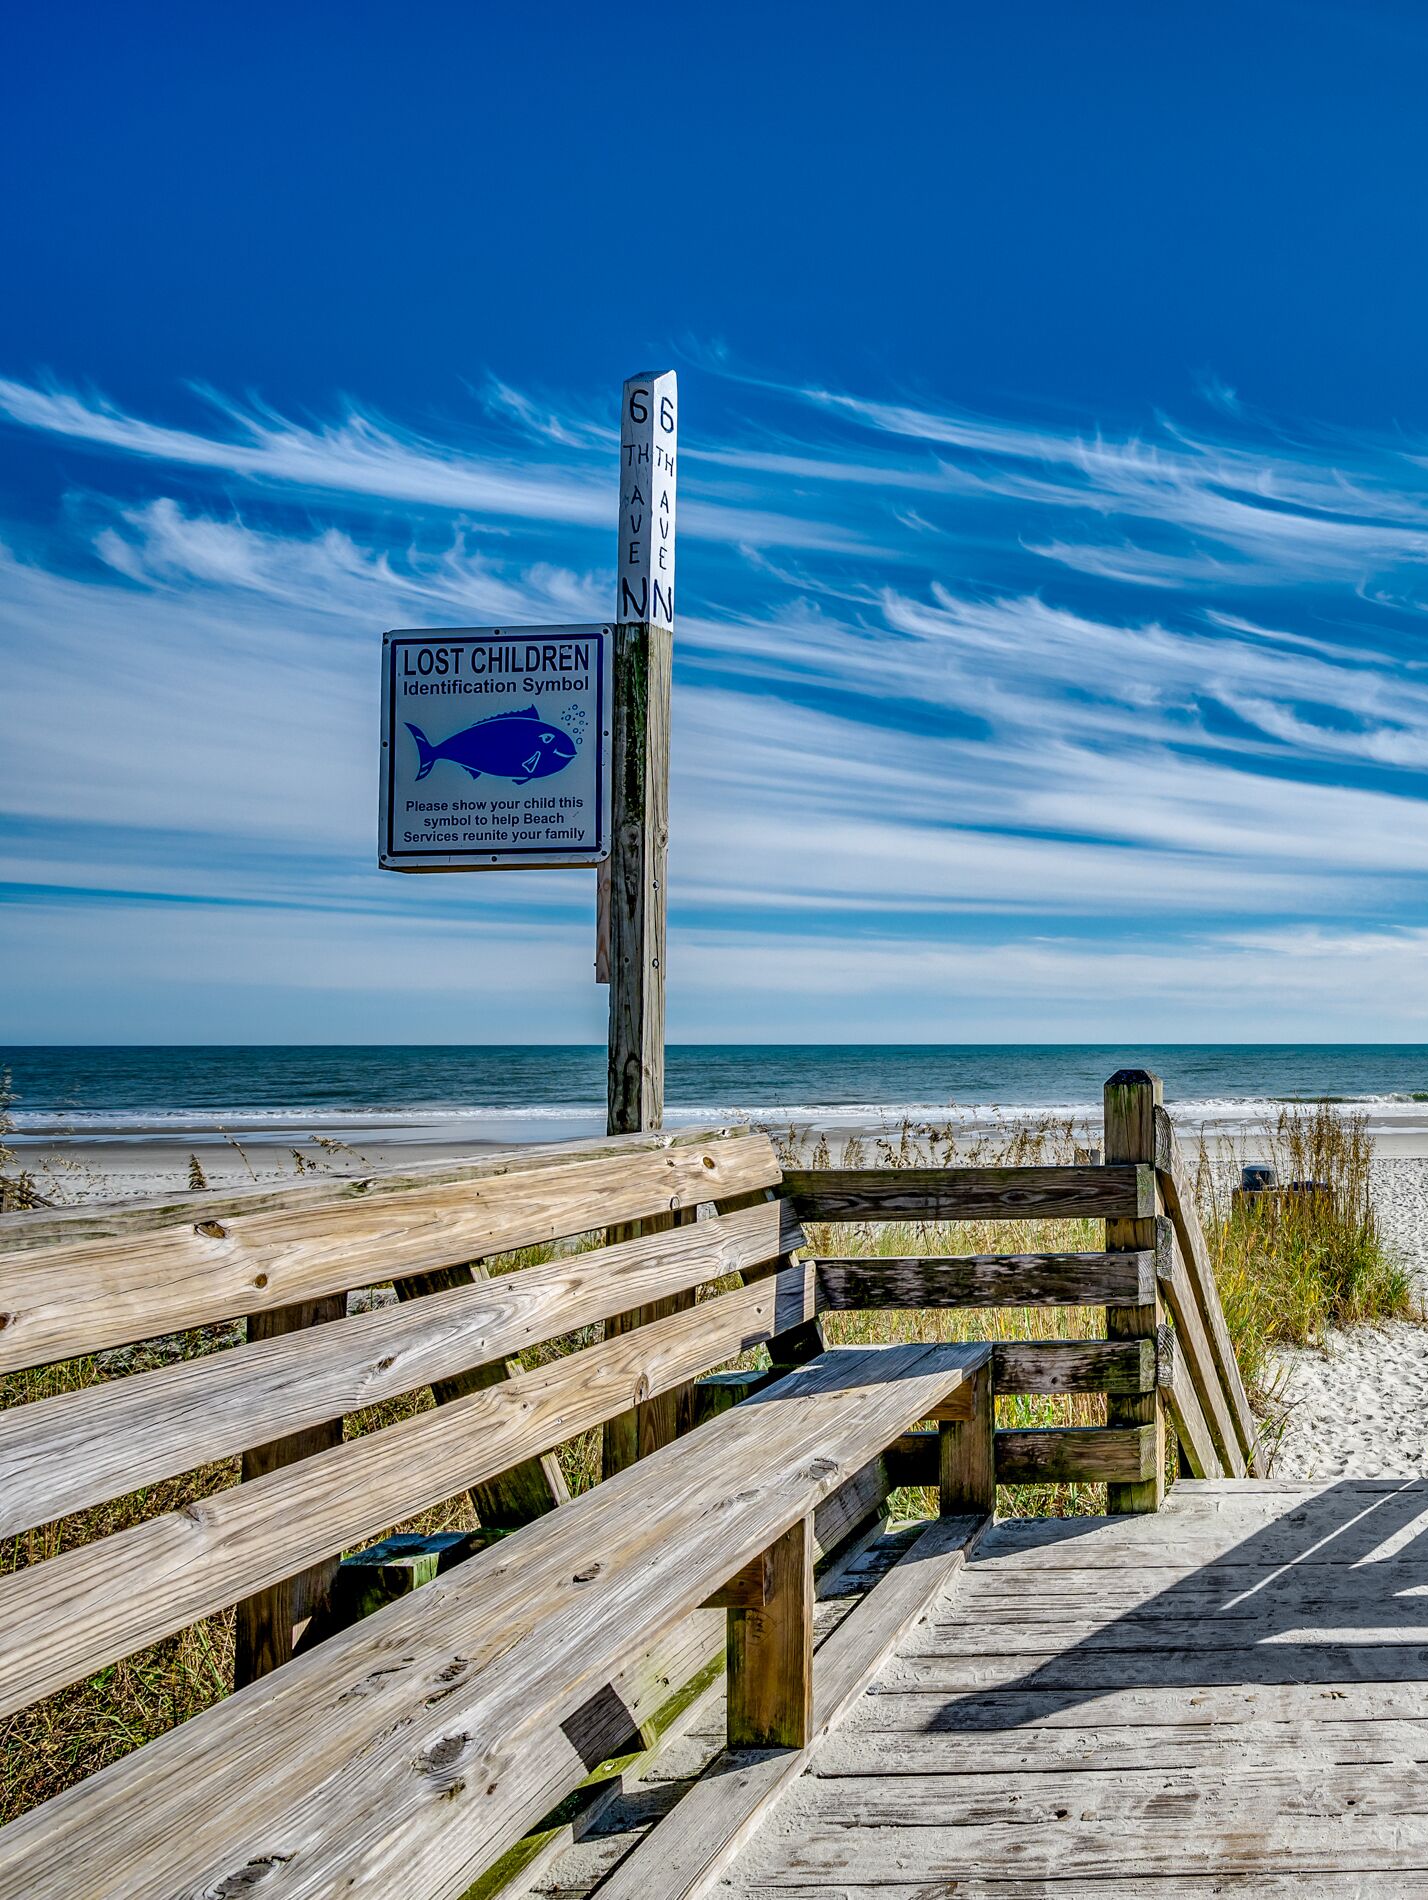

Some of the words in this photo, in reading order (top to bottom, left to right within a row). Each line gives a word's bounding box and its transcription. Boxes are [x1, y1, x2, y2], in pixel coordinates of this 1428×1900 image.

[630, 389, 649, 423] 6
[660, 397, 674, 433] 6
[623, 443, 649, 466] TH
[656, 445, 674, 477] TH
[622, 577, 648, 617] N
[653, 579, 672, 623] N
[403, 648, 464, 676] LOST
[471, 644, 589, 674] CHILDREN
[403, 679, 517, 696] Identification
[522, 676, 589, 696] Symbol
[406, 800, 448, 812] Please
[452, 800, 487, 811] show
[490, 801, 520, 812] your
[524, 798, 556, 809] child
[559, 797, 584, 808] this
[403, 831, 459, 843] Services
[463, 830, 508, 841] reunite
[512, 831, 542, 842] your
[545, 828, 585, 841] family
[424, 815, 471, 829] symbol
[475, 815, 488, 826] to
[491, 814, 519, 828] help
[524, 813, 564, 824] Beach
